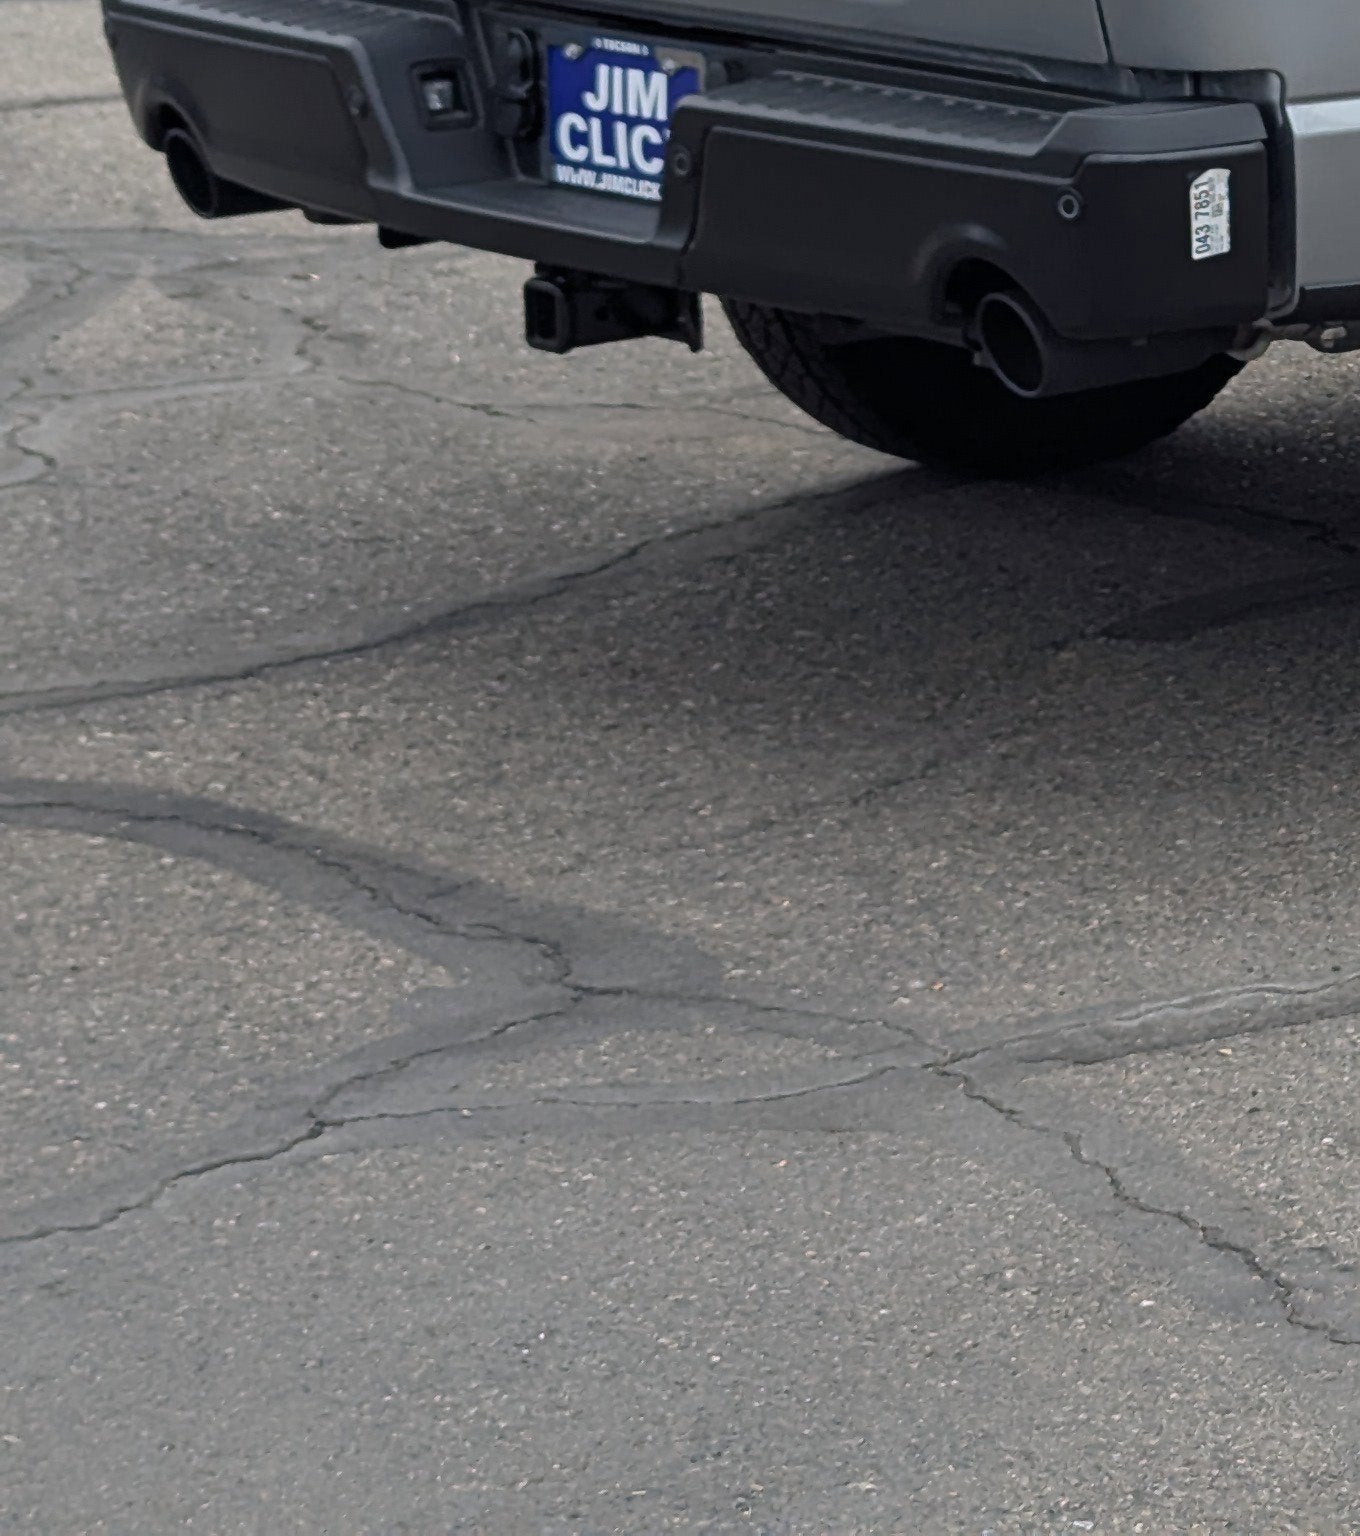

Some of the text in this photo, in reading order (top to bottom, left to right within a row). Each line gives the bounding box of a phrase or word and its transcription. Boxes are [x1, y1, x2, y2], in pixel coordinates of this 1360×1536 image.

[583, 63, 669, 121] JIM
[557, 112, 671, 175] CLIC
[1194, 181, 1211, 255] 043 7851
